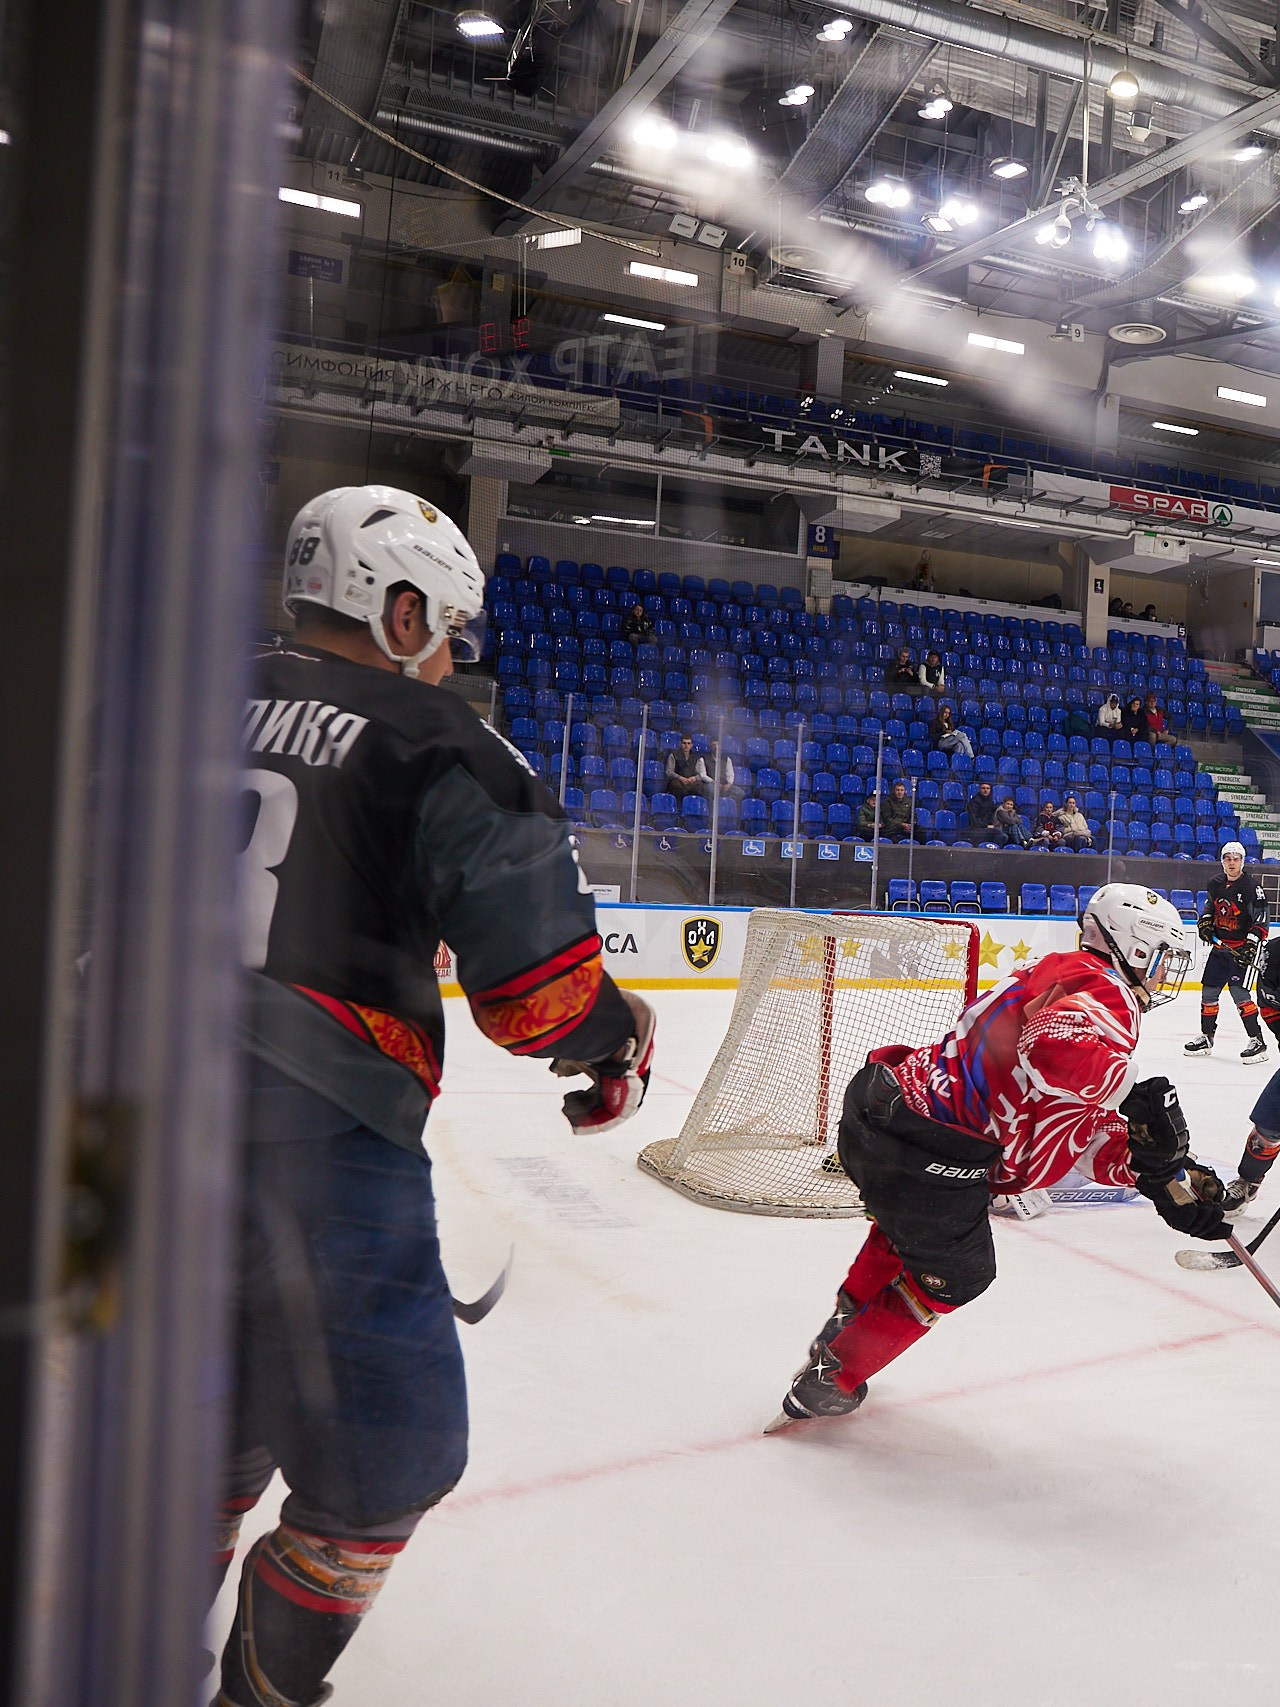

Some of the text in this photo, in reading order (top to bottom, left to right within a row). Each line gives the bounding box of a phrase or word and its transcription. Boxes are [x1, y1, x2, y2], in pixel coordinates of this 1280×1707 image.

[733, 256, 744, 268] 10
[1074, 328, 1080, 338] 9
[271, 350, 503, 400] СИМФОНИЯ НИЖНЕГО
[547, 398, 599, 414] КОМПЛЕКС
[761, 426, 909, 473] TANK
[1133, 493, 1207, 518] SPAR
[815, 526, 826, 544] 8
[289, 536, 320, 566] 88
[1178, 627, 1186, 636] 5
[1230, 794, 1254, 802] SYNERGETIC
[1246, 812, 1270, 820] SYNERGETIC
